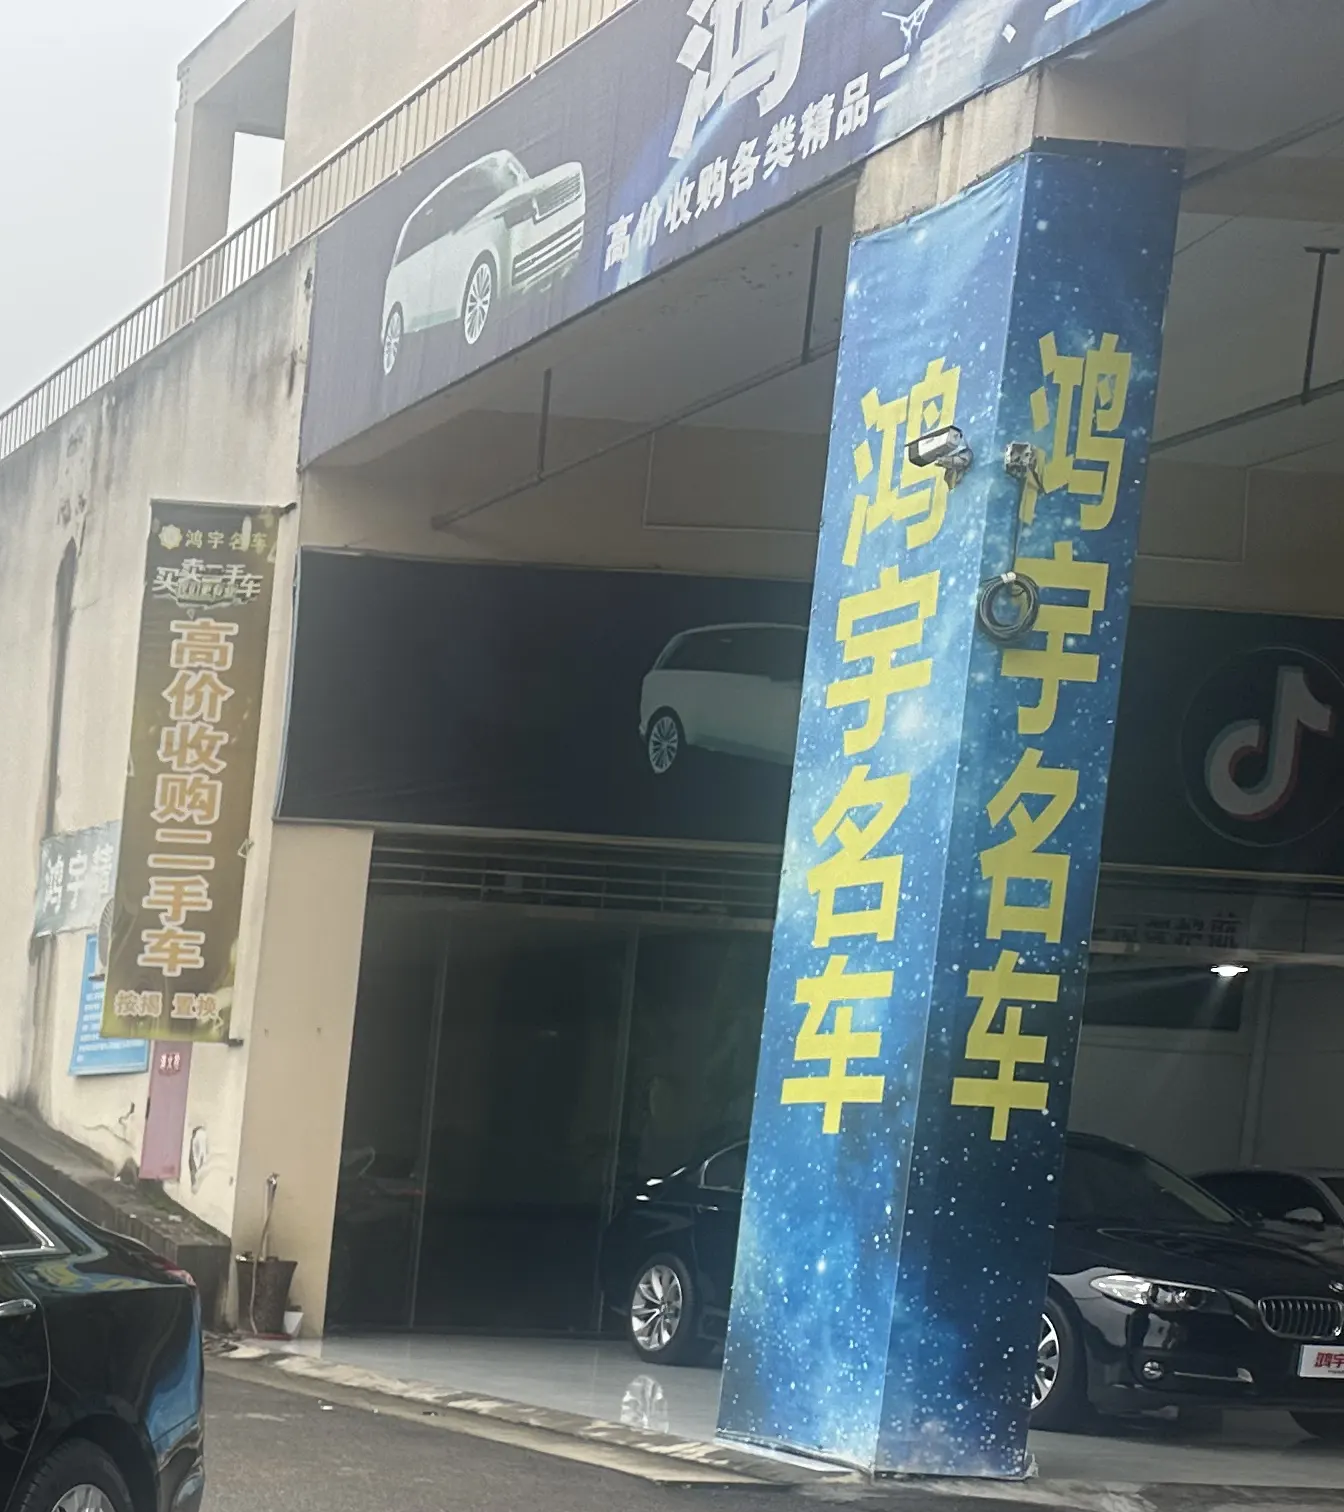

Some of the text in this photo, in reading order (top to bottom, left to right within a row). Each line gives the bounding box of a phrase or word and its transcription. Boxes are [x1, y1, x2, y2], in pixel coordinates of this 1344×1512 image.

[602, 0, 1082, 271] 高价收购各类精品二手车、
[670, 0, 809, 160] 鸿
[151, 558, 264, 598] 买卖二手车
[950, 330, 1133, 1141] 鸿宇名车
[137, 617, 239, 977] 高价收购二手车
[781, 356, 963, 1135] 鸿宇名车
